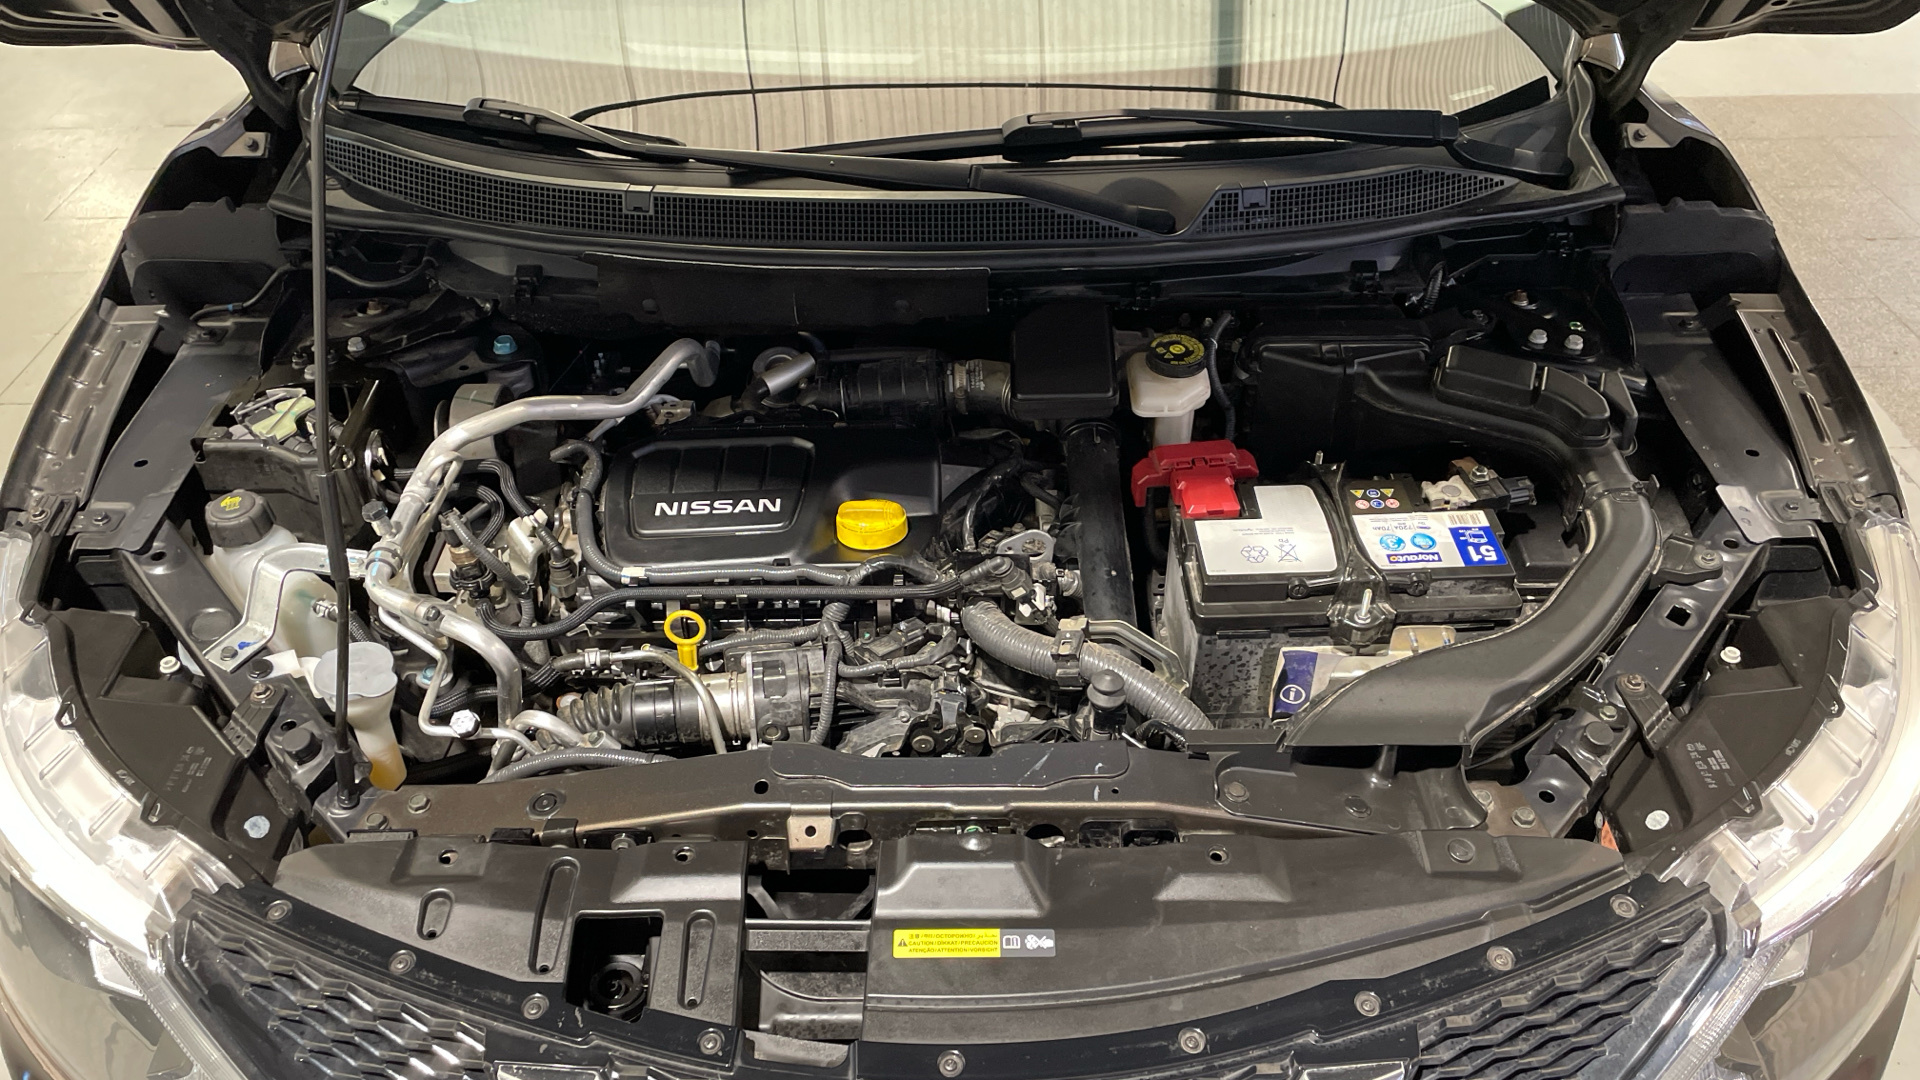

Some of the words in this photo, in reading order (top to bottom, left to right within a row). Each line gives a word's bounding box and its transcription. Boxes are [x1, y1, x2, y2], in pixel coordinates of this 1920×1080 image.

[654, 498, 782, 516] NISSAN
[1387, 538, 1399, 549] 3
[1389, 553, 1439, 562] Norauto
[1468, 545, 1498, 562] 51
